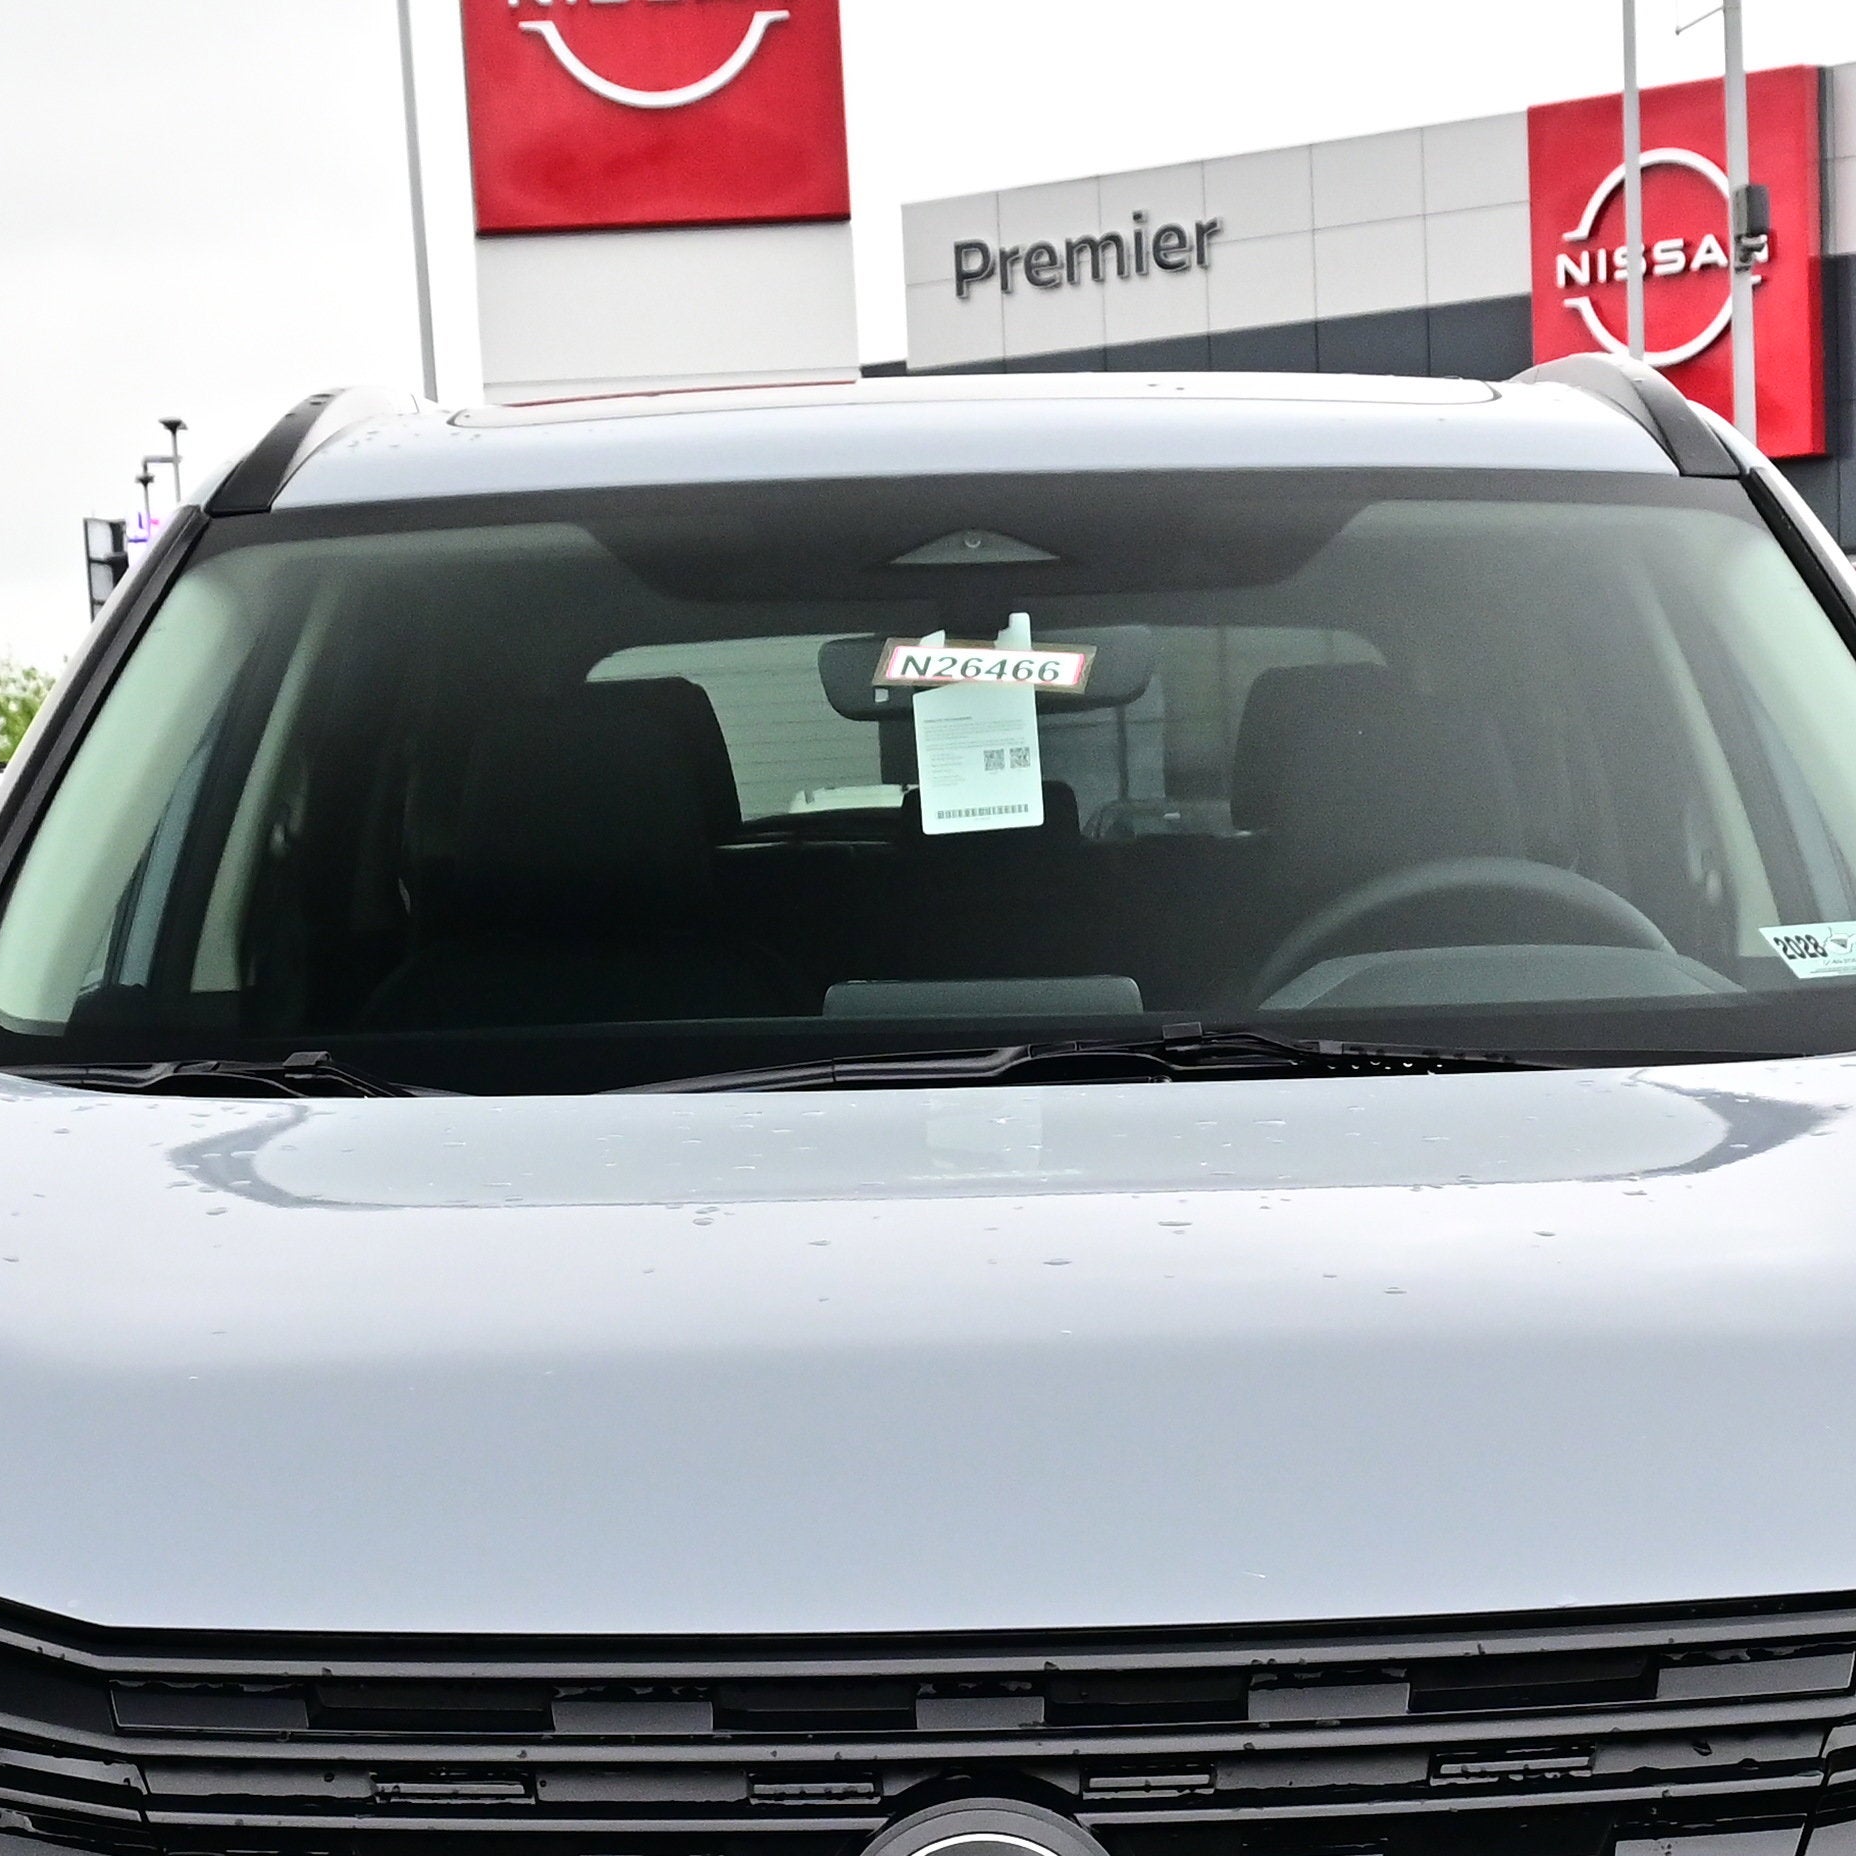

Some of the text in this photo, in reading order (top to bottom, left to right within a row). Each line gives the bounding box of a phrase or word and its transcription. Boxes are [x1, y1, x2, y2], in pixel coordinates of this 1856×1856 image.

[953, 208, 1223, 299] Premier
[1555, 232, 1770, 289] NISSA
[900, 655, 1061, 683] N26466
[1773, 933, 1829, 960] 2028
